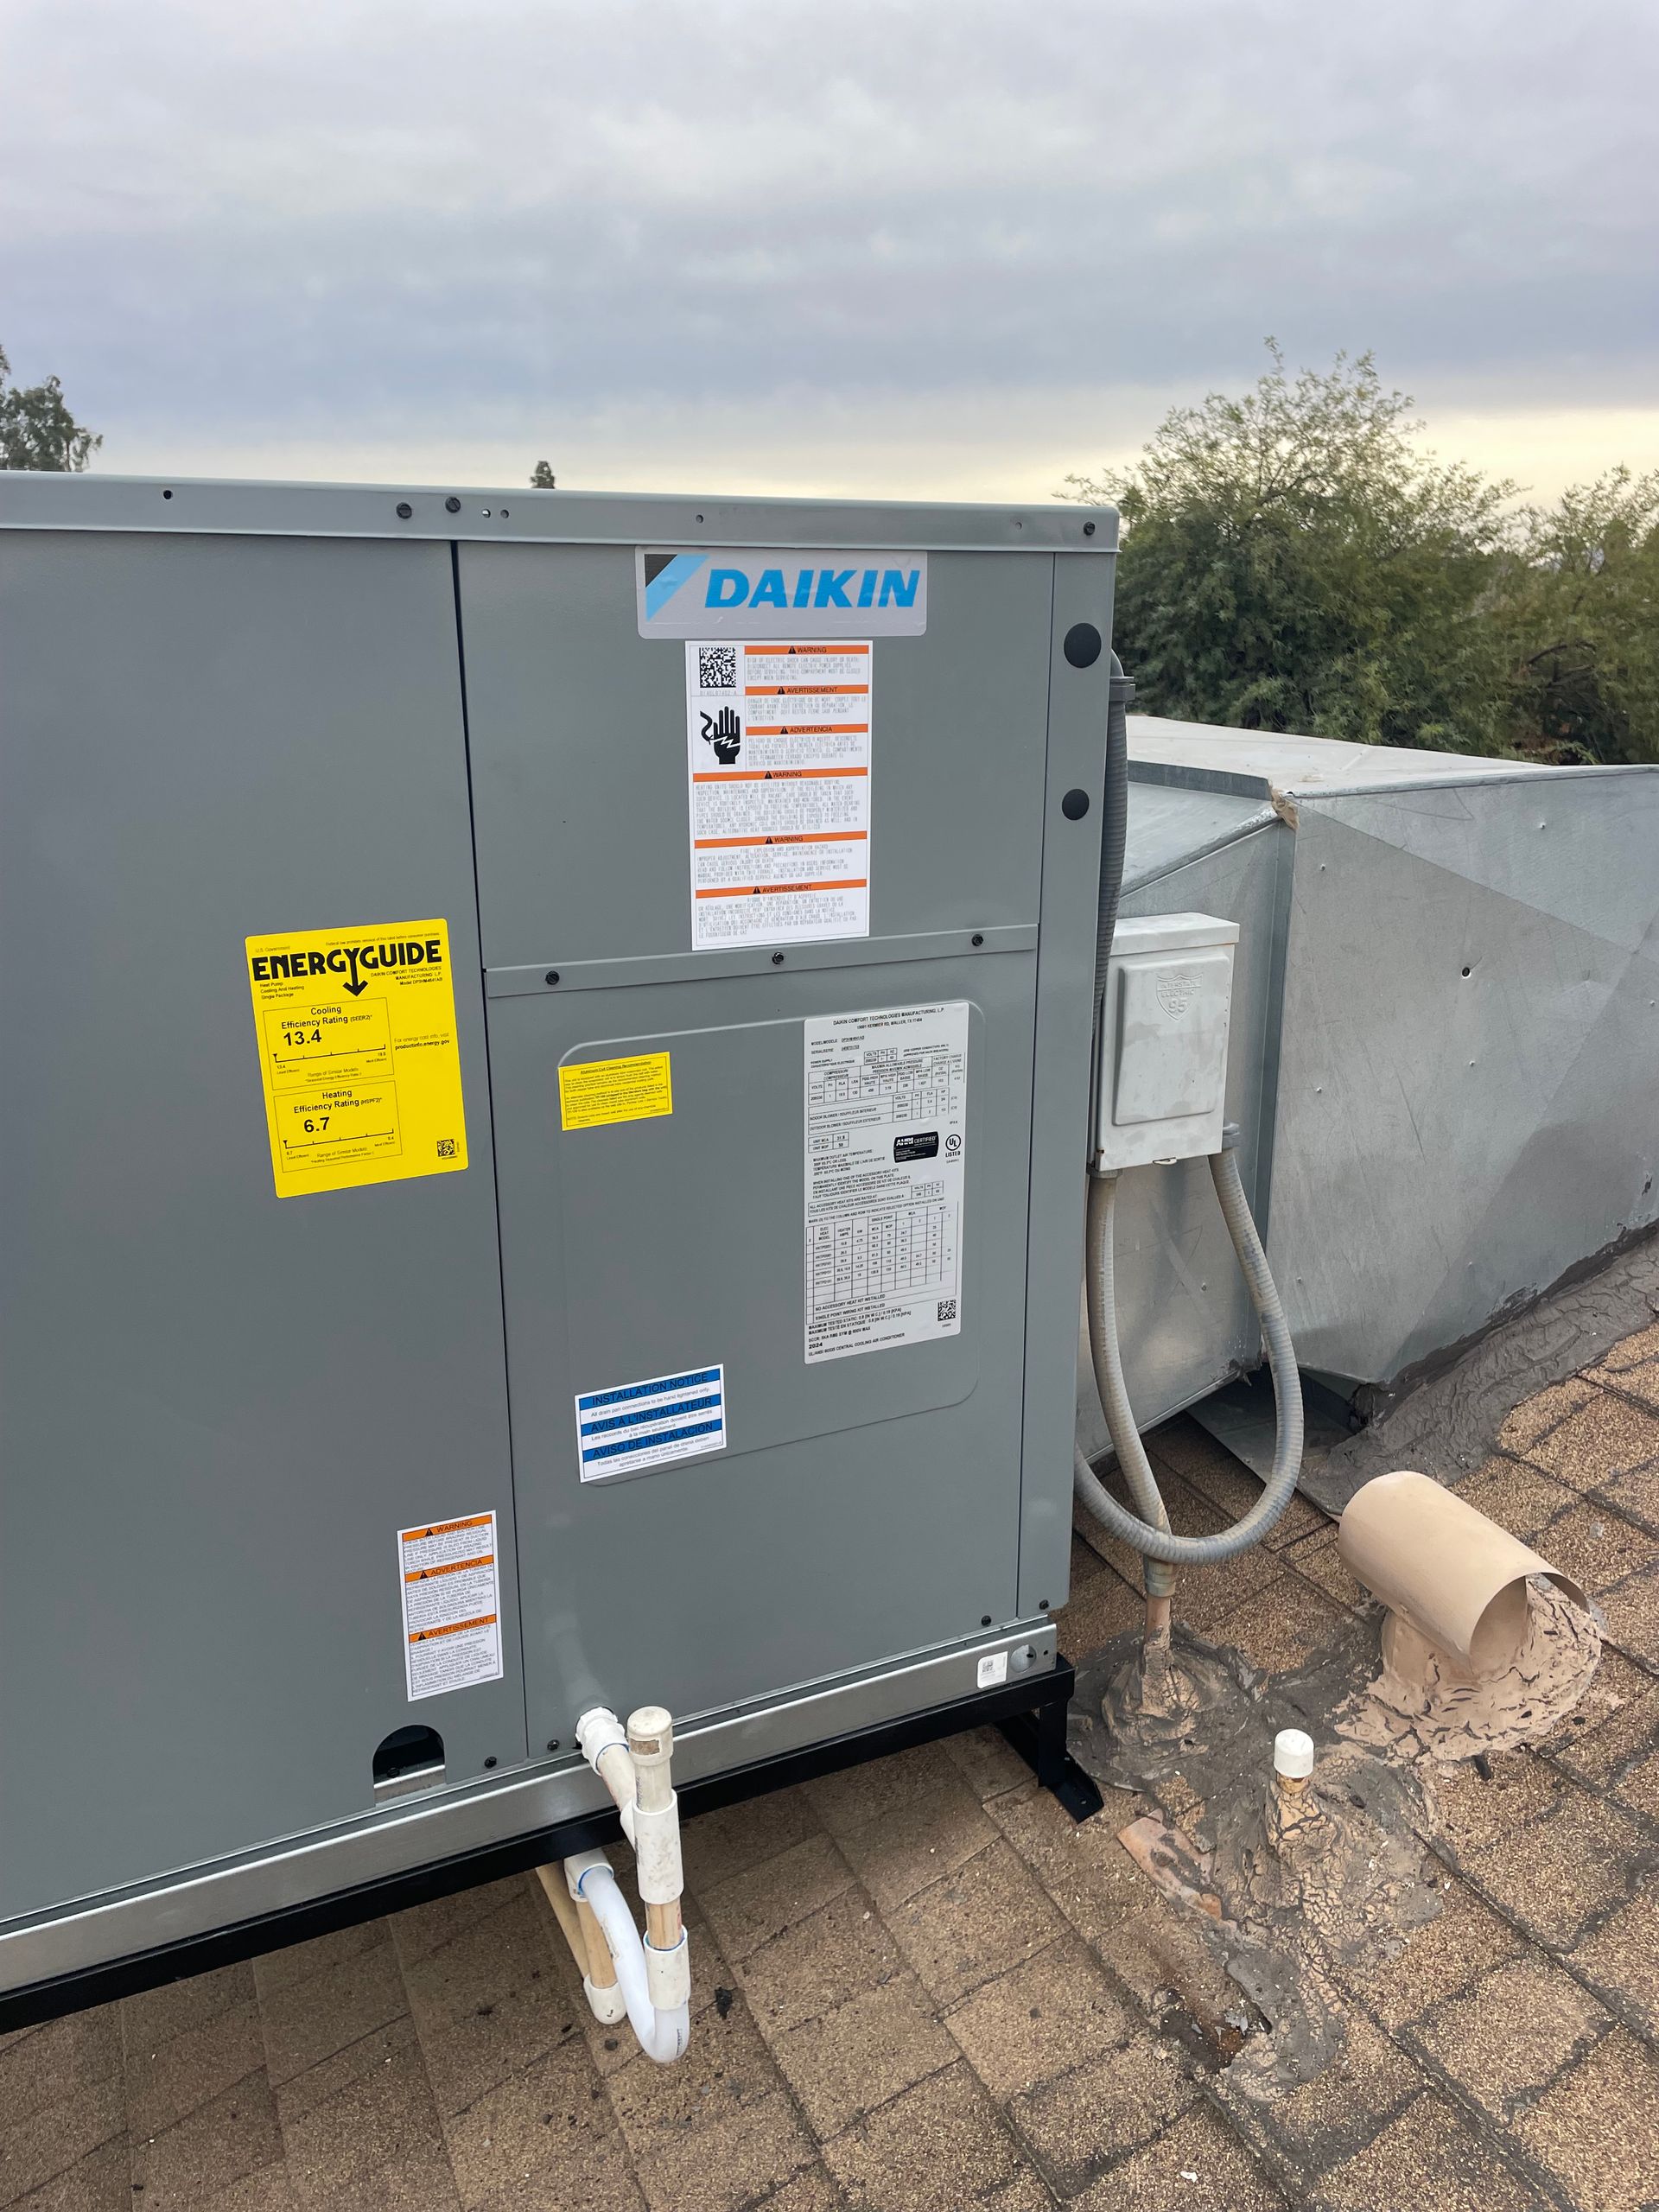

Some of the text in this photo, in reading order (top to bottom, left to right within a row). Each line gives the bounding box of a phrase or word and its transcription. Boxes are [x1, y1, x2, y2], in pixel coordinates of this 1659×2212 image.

[705, 569, 920, 608] DAIKIN
[762, 884, 811, 893] AVERTISSEMENT
[251, 939, 442, 985] ENERGYGUIDE
[1160, 989, 1195, 998] ELECTRIC
[310, 1005, 341, 1016] Cooling
[1168, 999, 1187, 1014] 95
[281, 1018, 321, 1030] Efficiency
[321, 1014, 348, 1025] Rating
[869, 1012, 900, 1021] TECHNOLOGIES
[283, 1028, 321, 1046] 13.4
[321, 1089, 352, 1100] Heating
[294, 1102, 332, 1115] Efficiency
[334, 1098, 359, 1109] Rating
[302, 1116, 330, 1133] 6.7
[879, 1332, 905, 1342] CONDITIONER
[592, 1372, 708, 1405] INSTALLATION NOTICE
[621, 1400, 650, 1410] connections
[591, 1419, 615, 1432] AVIS
[601, 1429, 622, 1438] raccords
[593, 1443, 625, 1458] AVISO
[627, 1439, 643, 1450] DE
[436, 1520, 472, 1533] WARNING
[430, 1558, 482, 1575] ADVERTENCIA
[428, 1617, 488, 1637] AVERTISSEMENT
